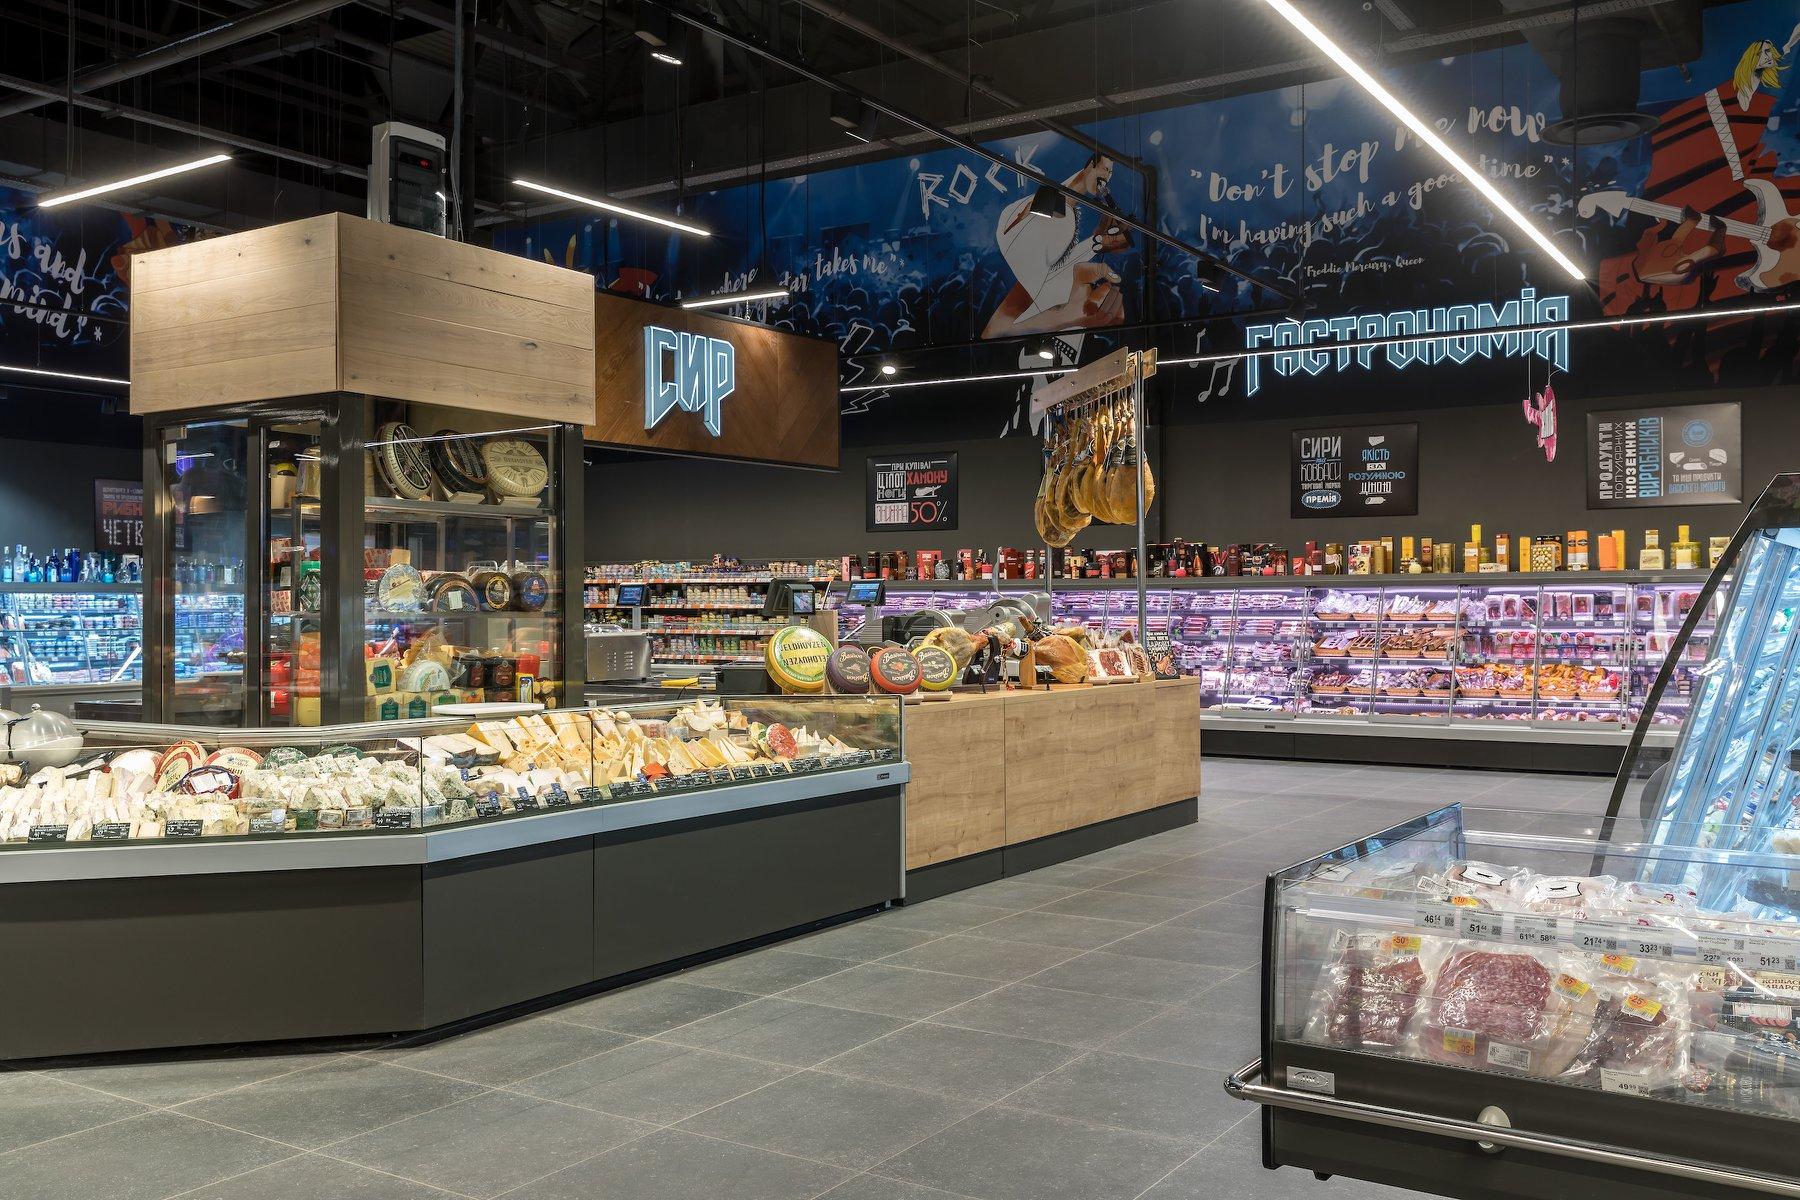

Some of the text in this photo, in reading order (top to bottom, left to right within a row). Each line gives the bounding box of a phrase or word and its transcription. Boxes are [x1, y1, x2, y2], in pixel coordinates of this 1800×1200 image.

[1306, 140, 1379, 193] stop
[1467, 104, 1545, 143] now
[917, 144, 1046, 220] ROCK
[1199, 213, 1235, 245] I'm
[1239, 218, 1318, 249] having
[1322, 191, 1376, 233] such
[1381, 190, 1402, 207] a
[34, 244, 86, 295] and
[815, 246, 860, 282] takes
[1395, 253, 1427, 268] Queen
[643, 325, 735, 437] СИР
[1300, 436, 1341, 459] СИРИ
[1361, 447, 1391, 462] ЯКІСТЬ
[1599, 421, 1613, 500] ПРОДУКТИ
[1614, 421, 1624, 499] ПОПУЛЯРНИХ
[1625, 421, 1637, 499] ІНОЗЕМНИХ
[1638, 417, 1660, 498] ВИРОБНИКІВ
[878, 469, 948, 489] ЦІЛОЇ ХАМОНУ
[1348, 471, 1406, 481] РОЗУМНОЮ
[1360, 481, 1393, 495] ЦІНОЮ
[911, 500, 948, 524] 50%
